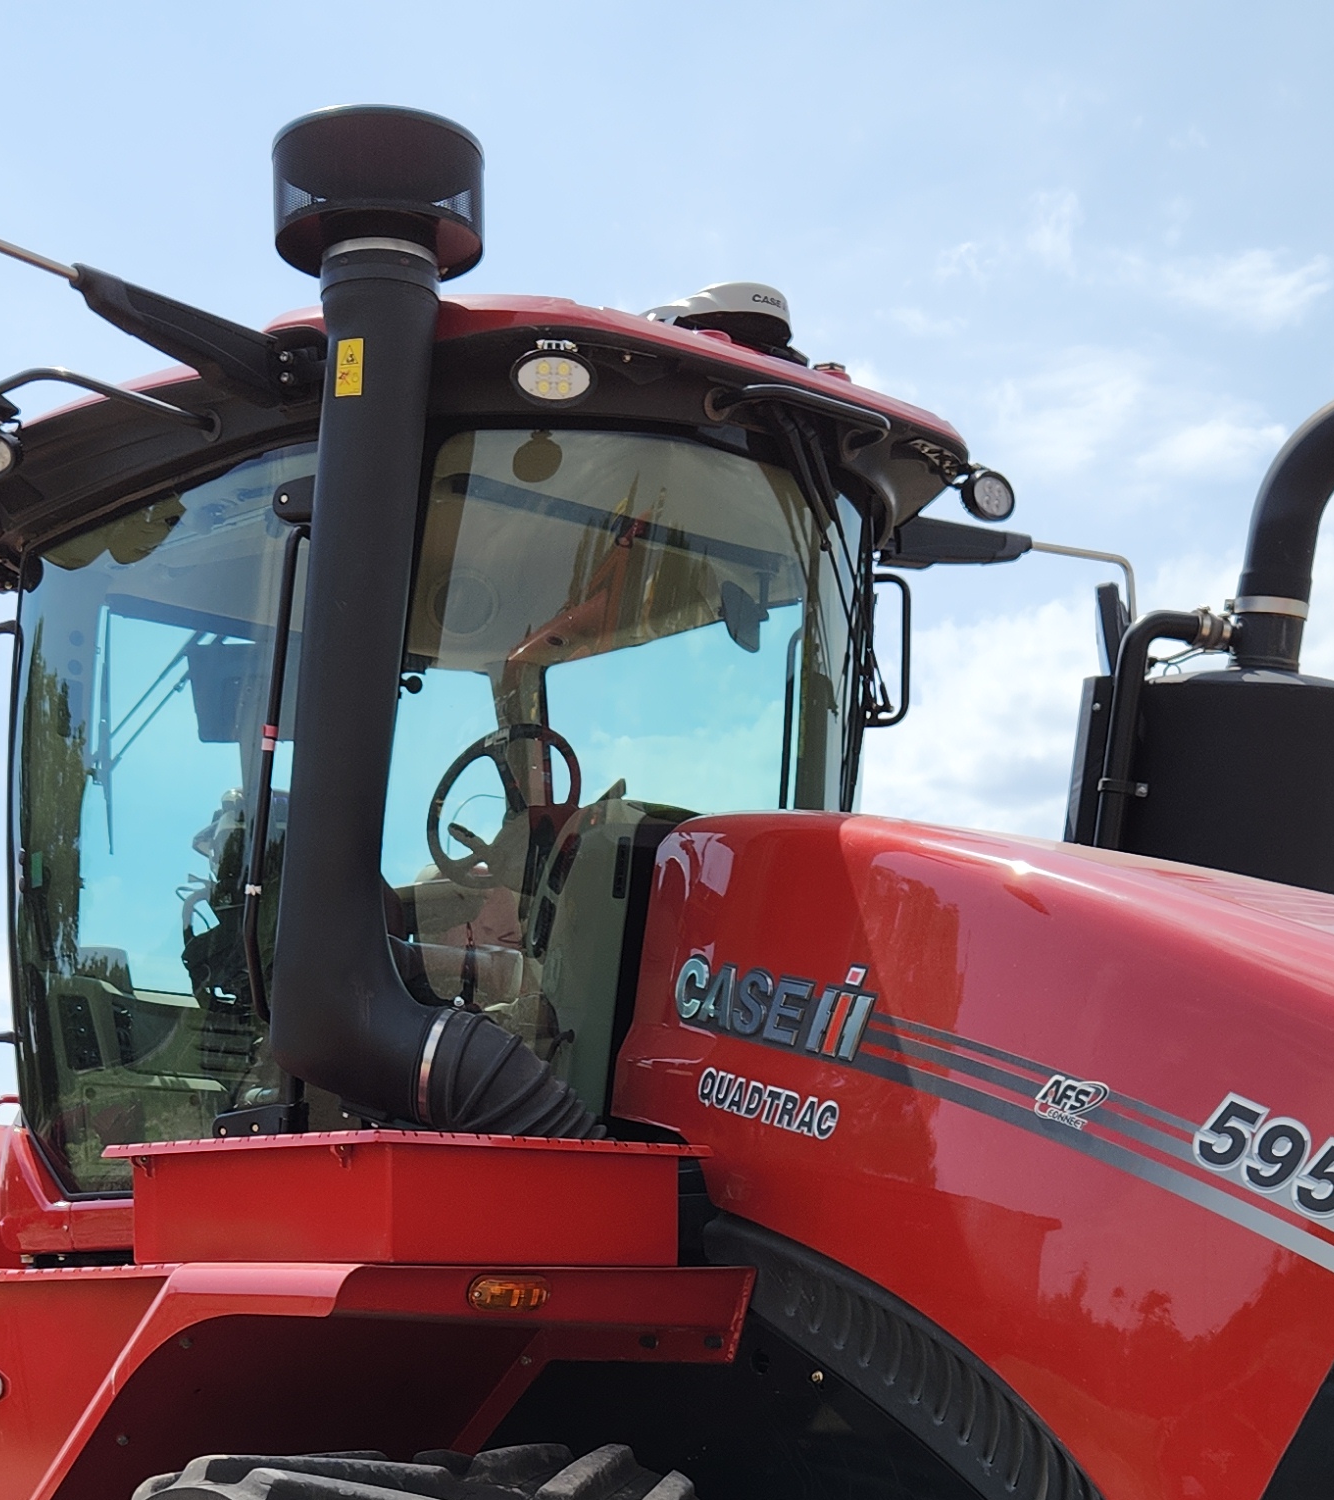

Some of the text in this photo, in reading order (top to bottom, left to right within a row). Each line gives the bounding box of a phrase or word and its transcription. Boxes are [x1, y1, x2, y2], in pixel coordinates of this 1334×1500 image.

[752, 293, 781, 309] CASE
[675, 954, 815, 1047] CASE
[698, 1066, 840, 1140] QUADTRAC
[1035, 1074, 1097, 1113] AFS
[1046, 1107, 1089, 1131] CONNECT
